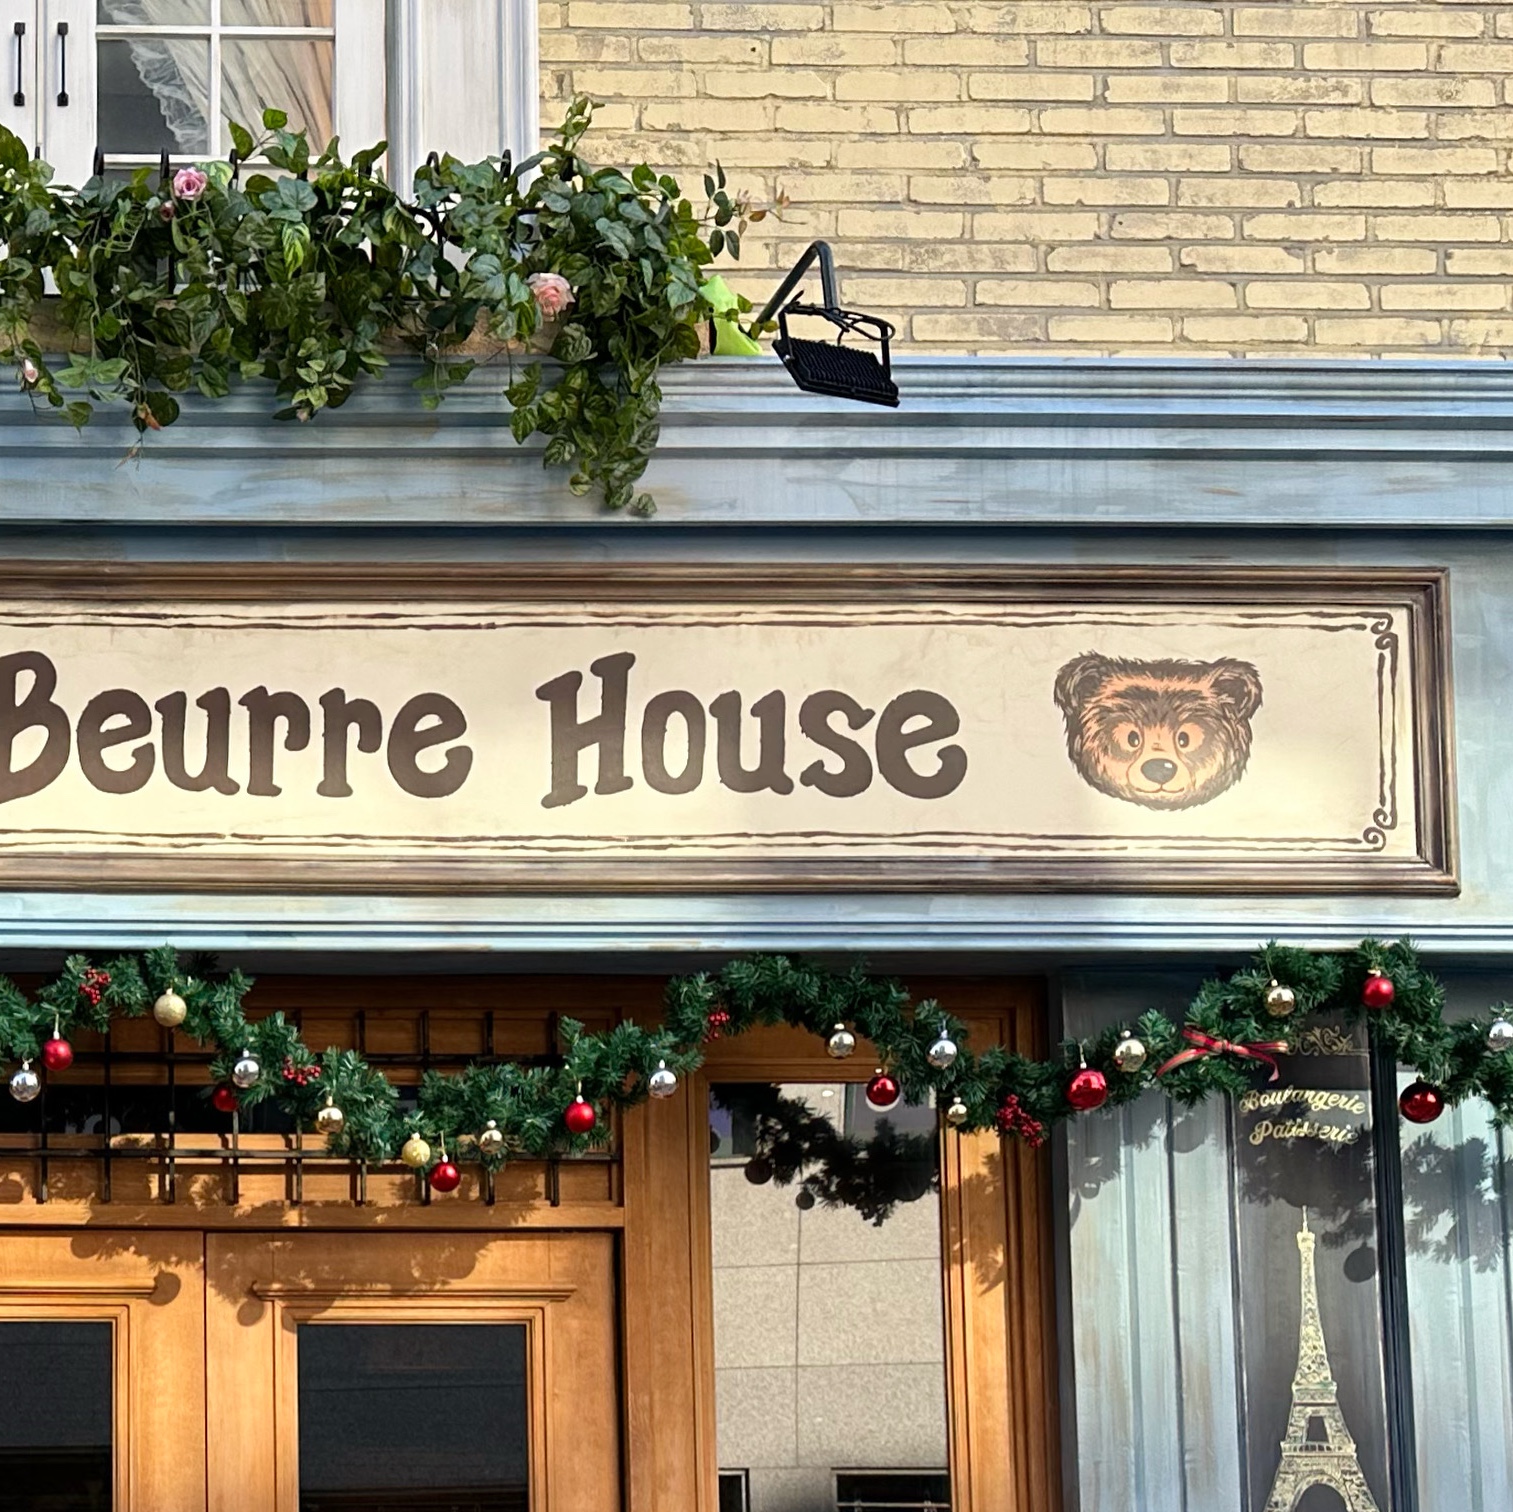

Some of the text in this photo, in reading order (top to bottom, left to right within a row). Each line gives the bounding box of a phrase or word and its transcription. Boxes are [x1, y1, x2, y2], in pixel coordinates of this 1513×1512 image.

[535, 652, 968, 808] House
[1239, 1085, 1366, 1115] Boulangerie
[1249, 1119, 1359, 1146] Patisserie
